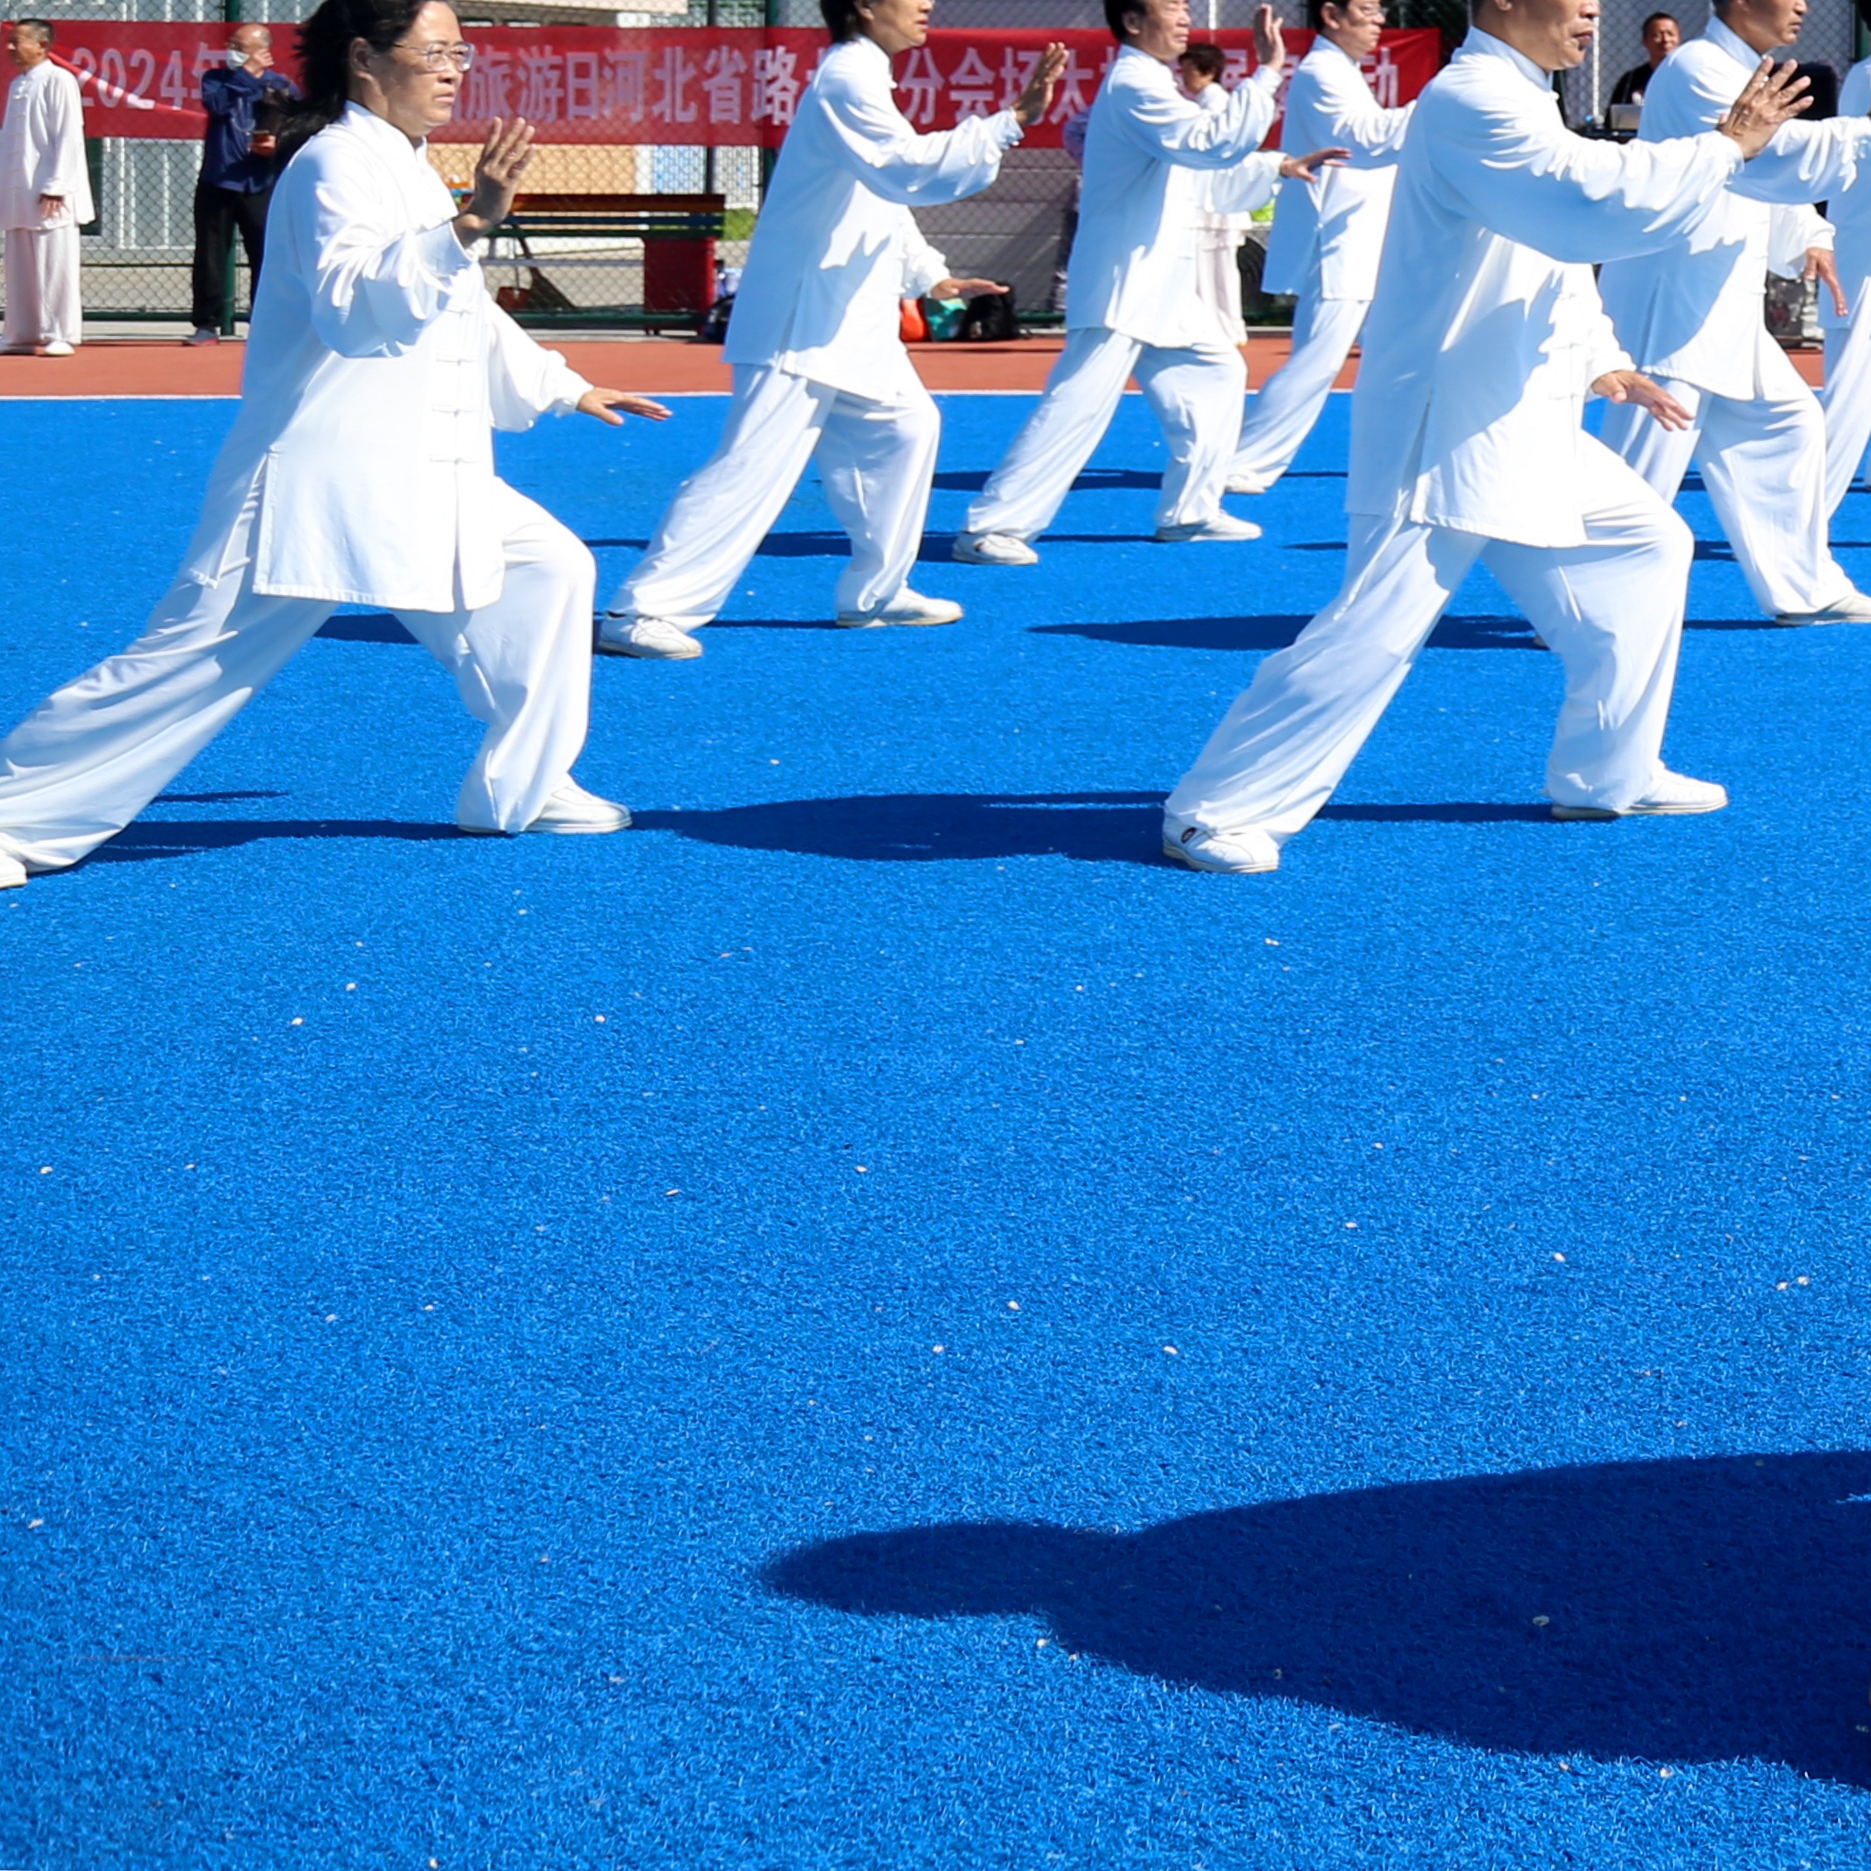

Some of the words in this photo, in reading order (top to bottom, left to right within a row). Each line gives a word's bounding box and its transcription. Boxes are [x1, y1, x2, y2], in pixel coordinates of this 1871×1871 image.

[463, 43, 820, 126] 旅游日河北省路
